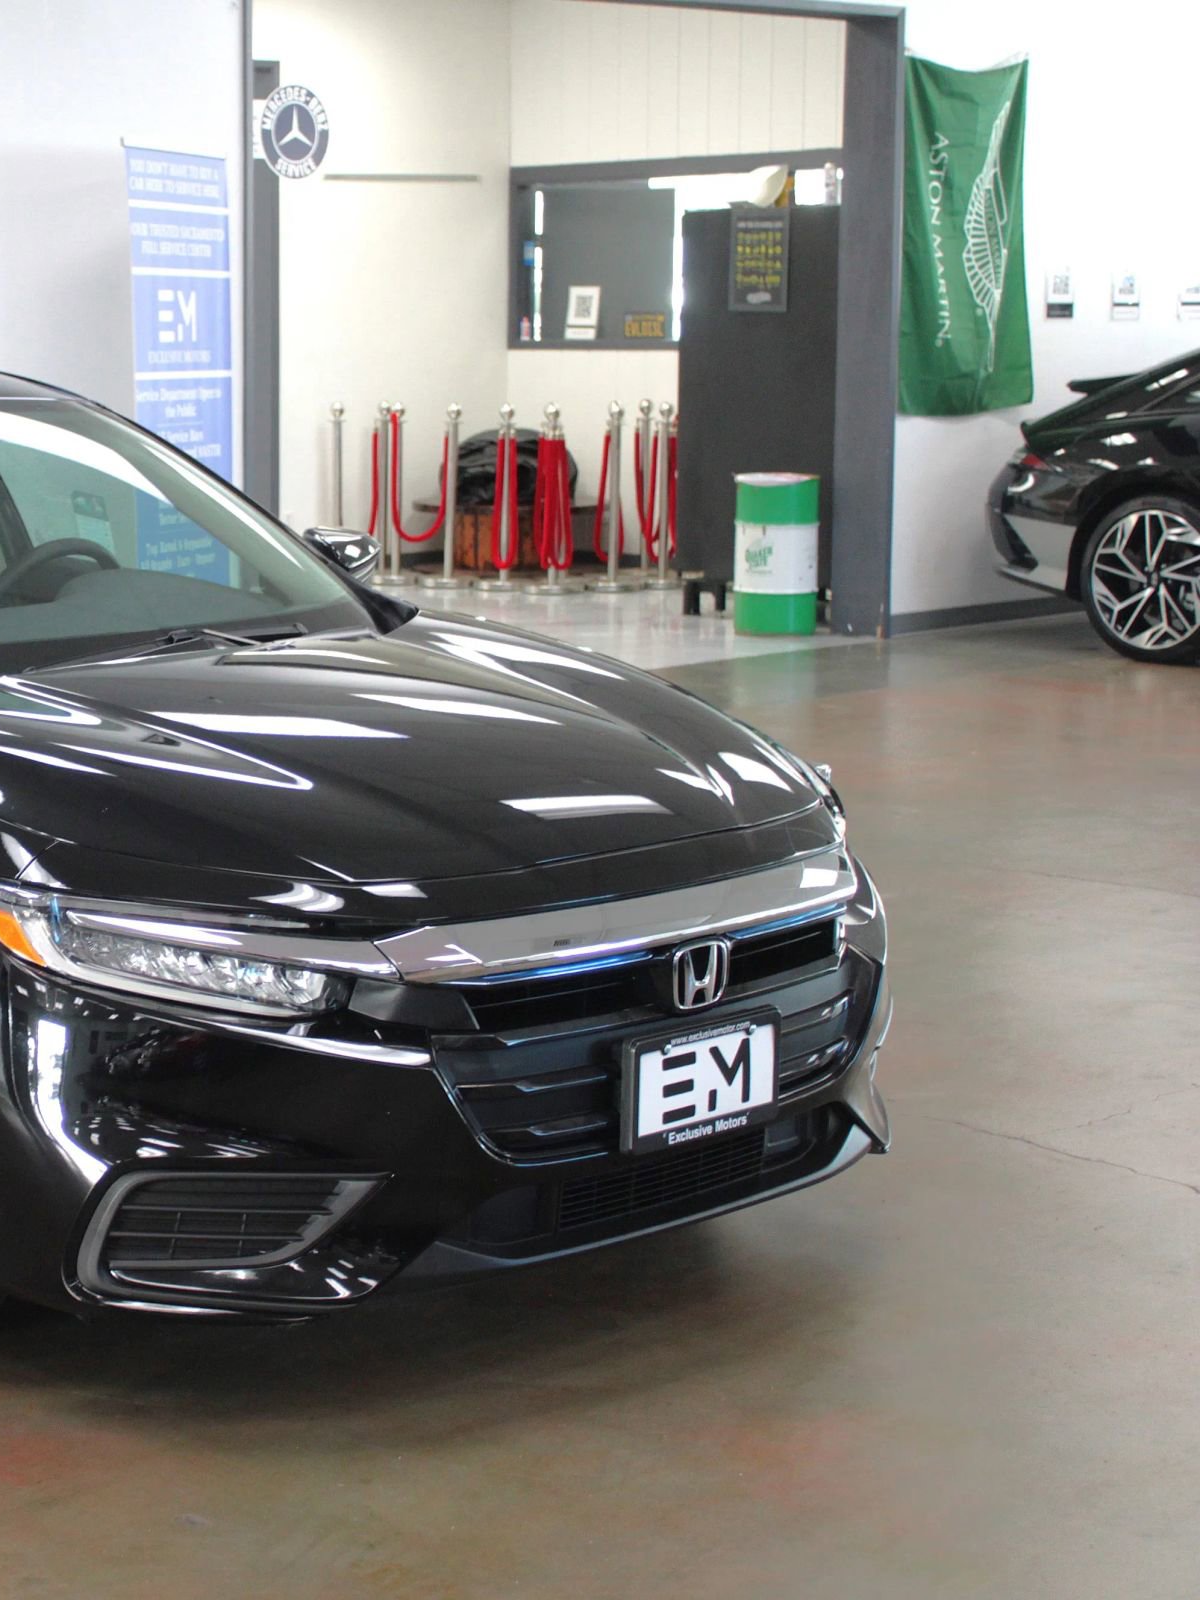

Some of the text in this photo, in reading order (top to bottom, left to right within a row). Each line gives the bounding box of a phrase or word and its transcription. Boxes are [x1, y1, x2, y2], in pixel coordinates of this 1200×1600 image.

[928, 131, 952, 339] ASTON MARTIN
[662, 1037, 751, 1125] EM
